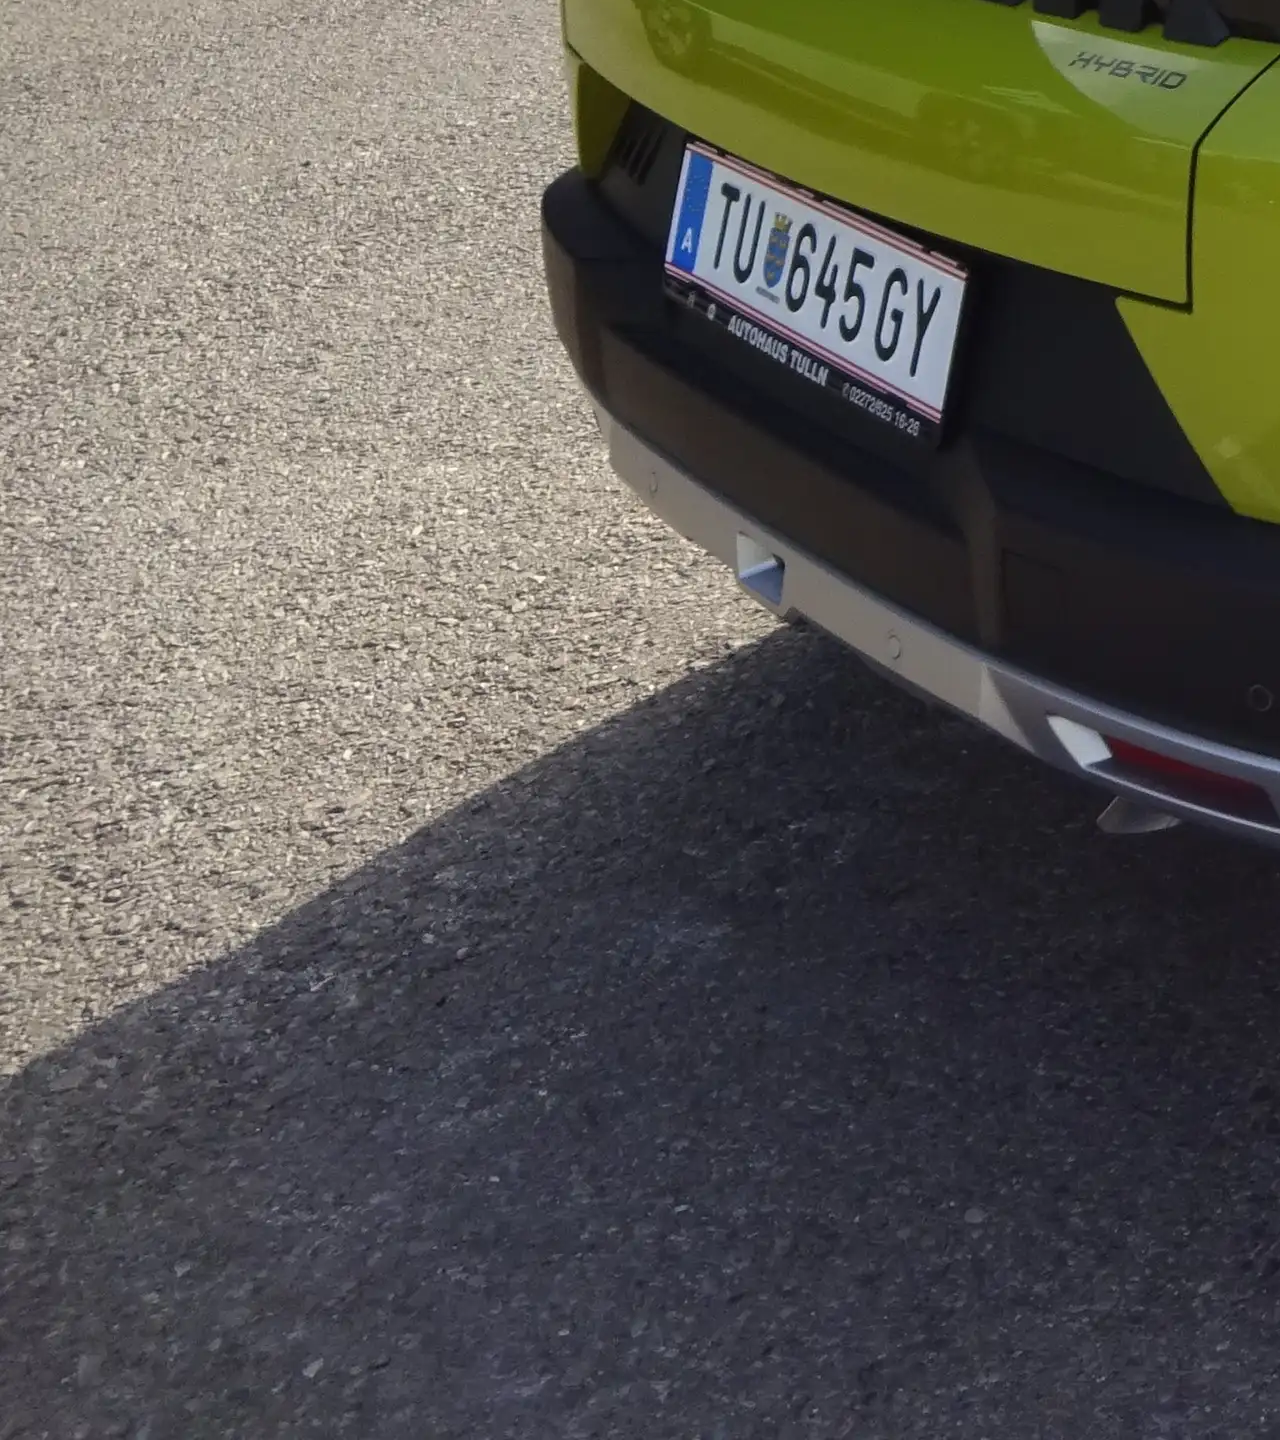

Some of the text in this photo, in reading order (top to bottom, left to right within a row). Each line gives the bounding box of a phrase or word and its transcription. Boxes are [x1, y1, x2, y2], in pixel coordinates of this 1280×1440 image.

[1069, 51, 1188, 91] HYBRID
[681, 227, 693, 254] A
[714, 182, 766, 284] TU
[727, 314, 790, 364] AUTOHAUS
[789, 349, 829, 387] TULLN
